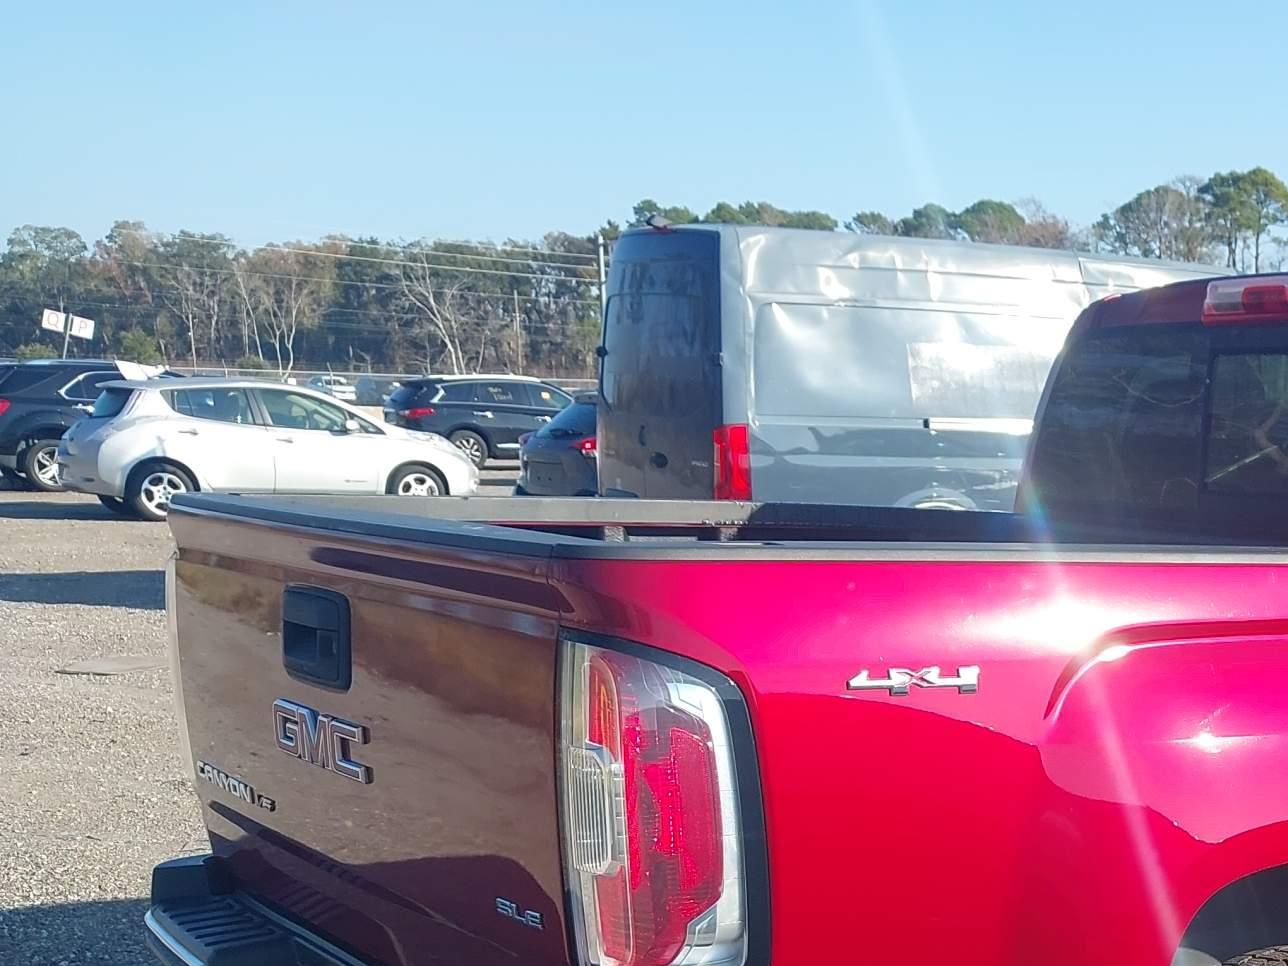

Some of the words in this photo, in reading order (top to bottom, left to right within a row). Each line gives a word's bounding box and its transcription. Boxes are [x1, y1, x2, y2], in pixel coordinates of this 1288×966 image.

[47, 312, 59, 329] Q
[272, 698, 374, 784] GMC
[196, 760, 255, 804] CANYON
[495, 897, 544, 930] SLE
